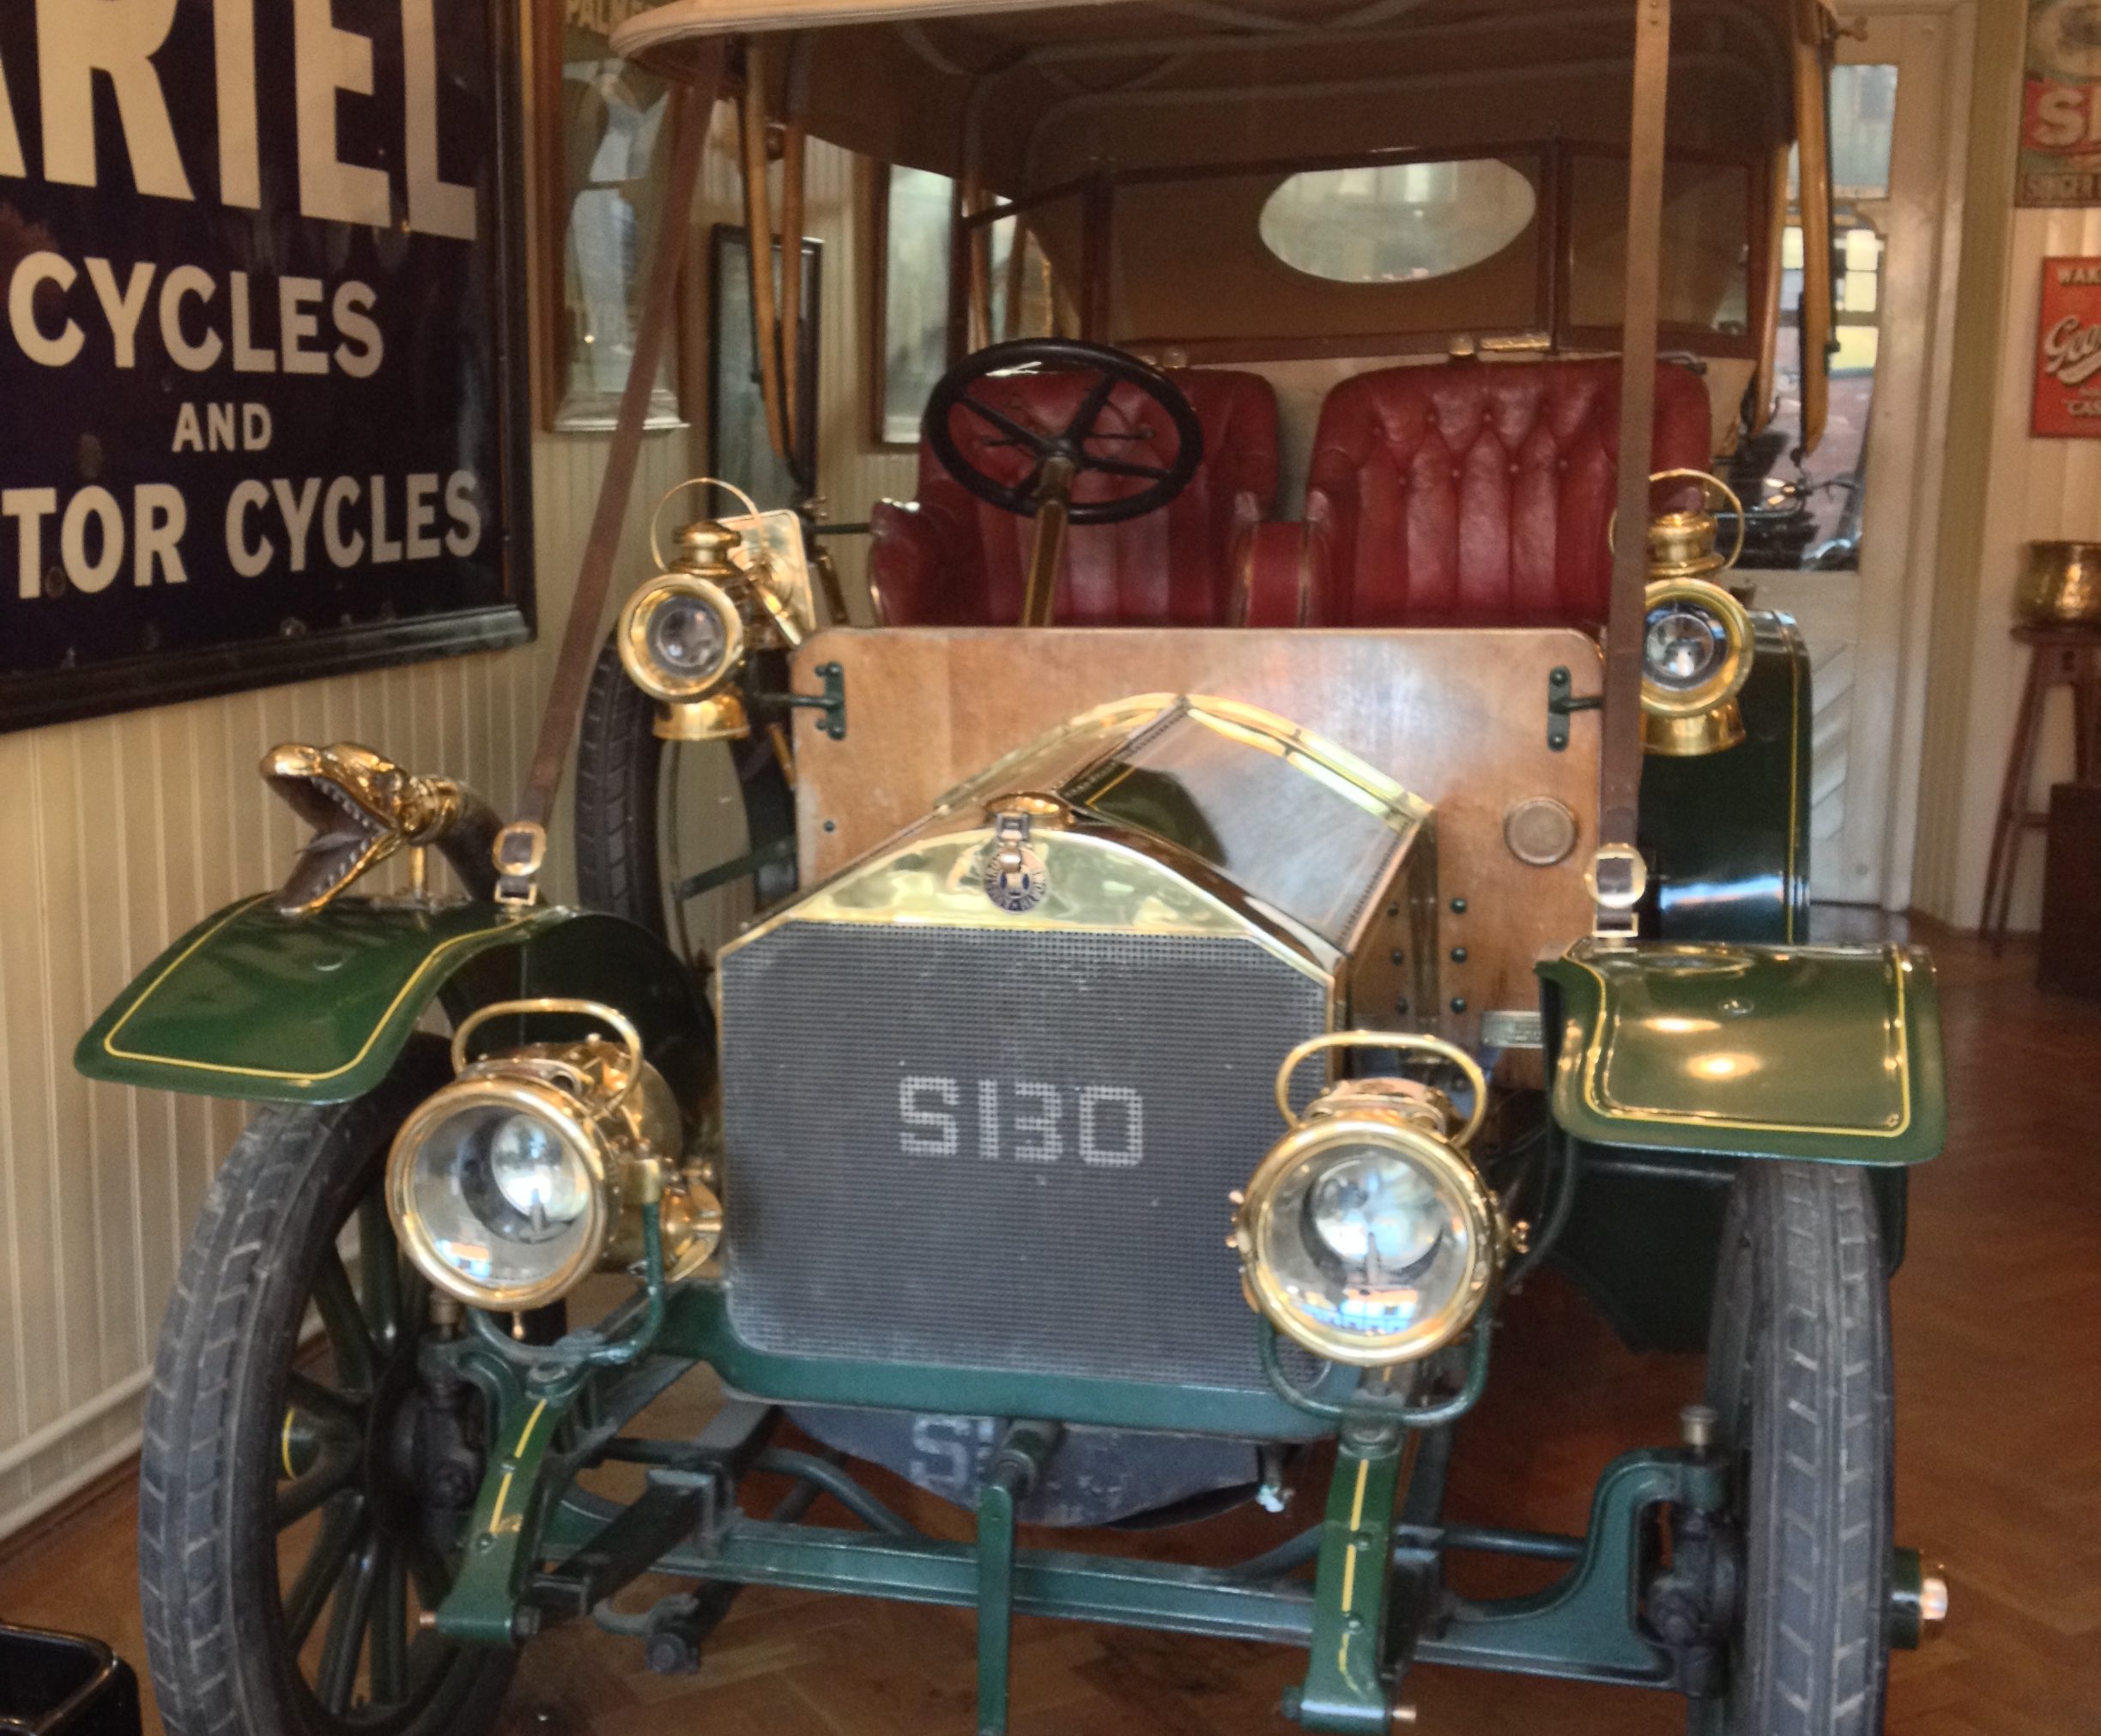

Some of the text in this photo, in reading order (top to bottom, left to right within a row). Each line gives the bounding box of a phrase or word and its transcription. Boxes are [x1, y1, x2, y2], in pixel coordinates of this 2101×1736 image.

[0, 0, 476, 240] RIEL
[9, 251, 384, 378] CYCLES
[172, 402, 272, 452] AND
[1, 469, 481, 599] TOR CYCLES
